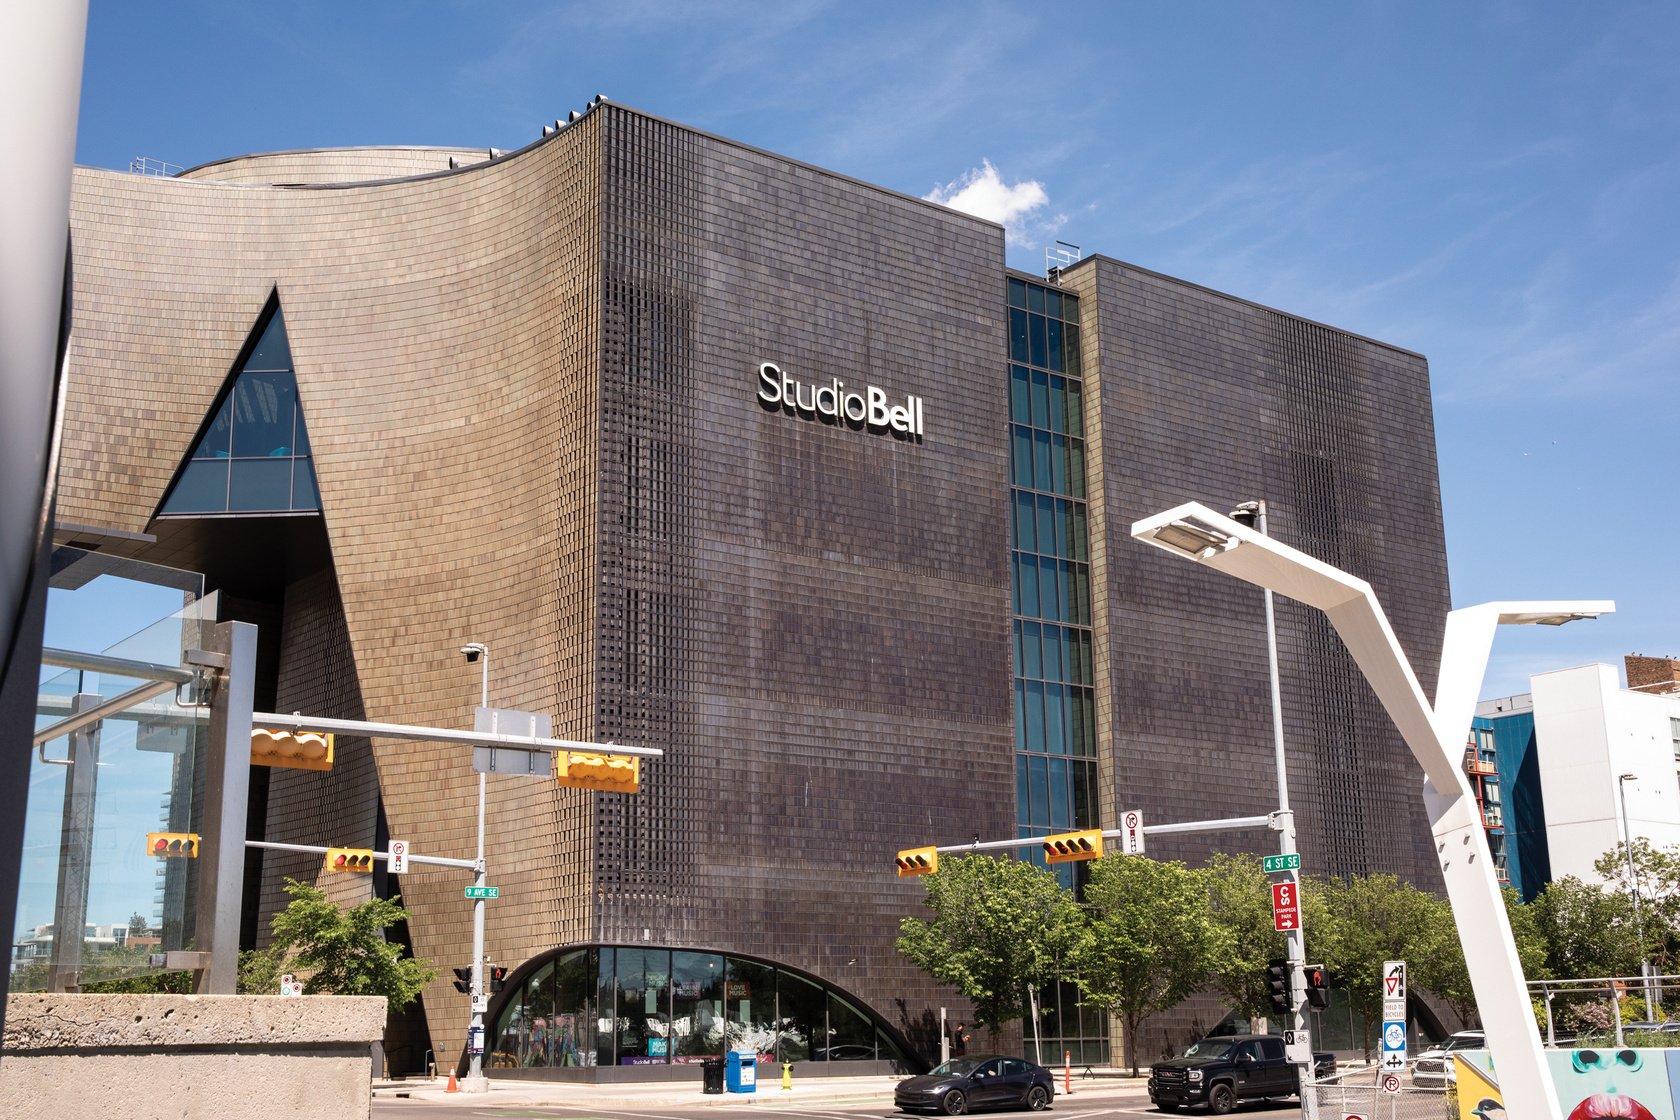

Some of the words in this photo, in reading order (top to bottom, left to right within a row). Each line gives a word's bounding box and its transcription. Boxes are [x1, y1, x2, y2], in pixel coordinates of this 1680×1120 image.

[1266, 859, 1272, 870] 4
[1275, 857, 1284, 869] ST
[1288, 856, 1298, 868] SE
[467, 888, 472, 896] 9
[474, 888, 486, 897] AVE
[488, 889, 497, 897] SE
